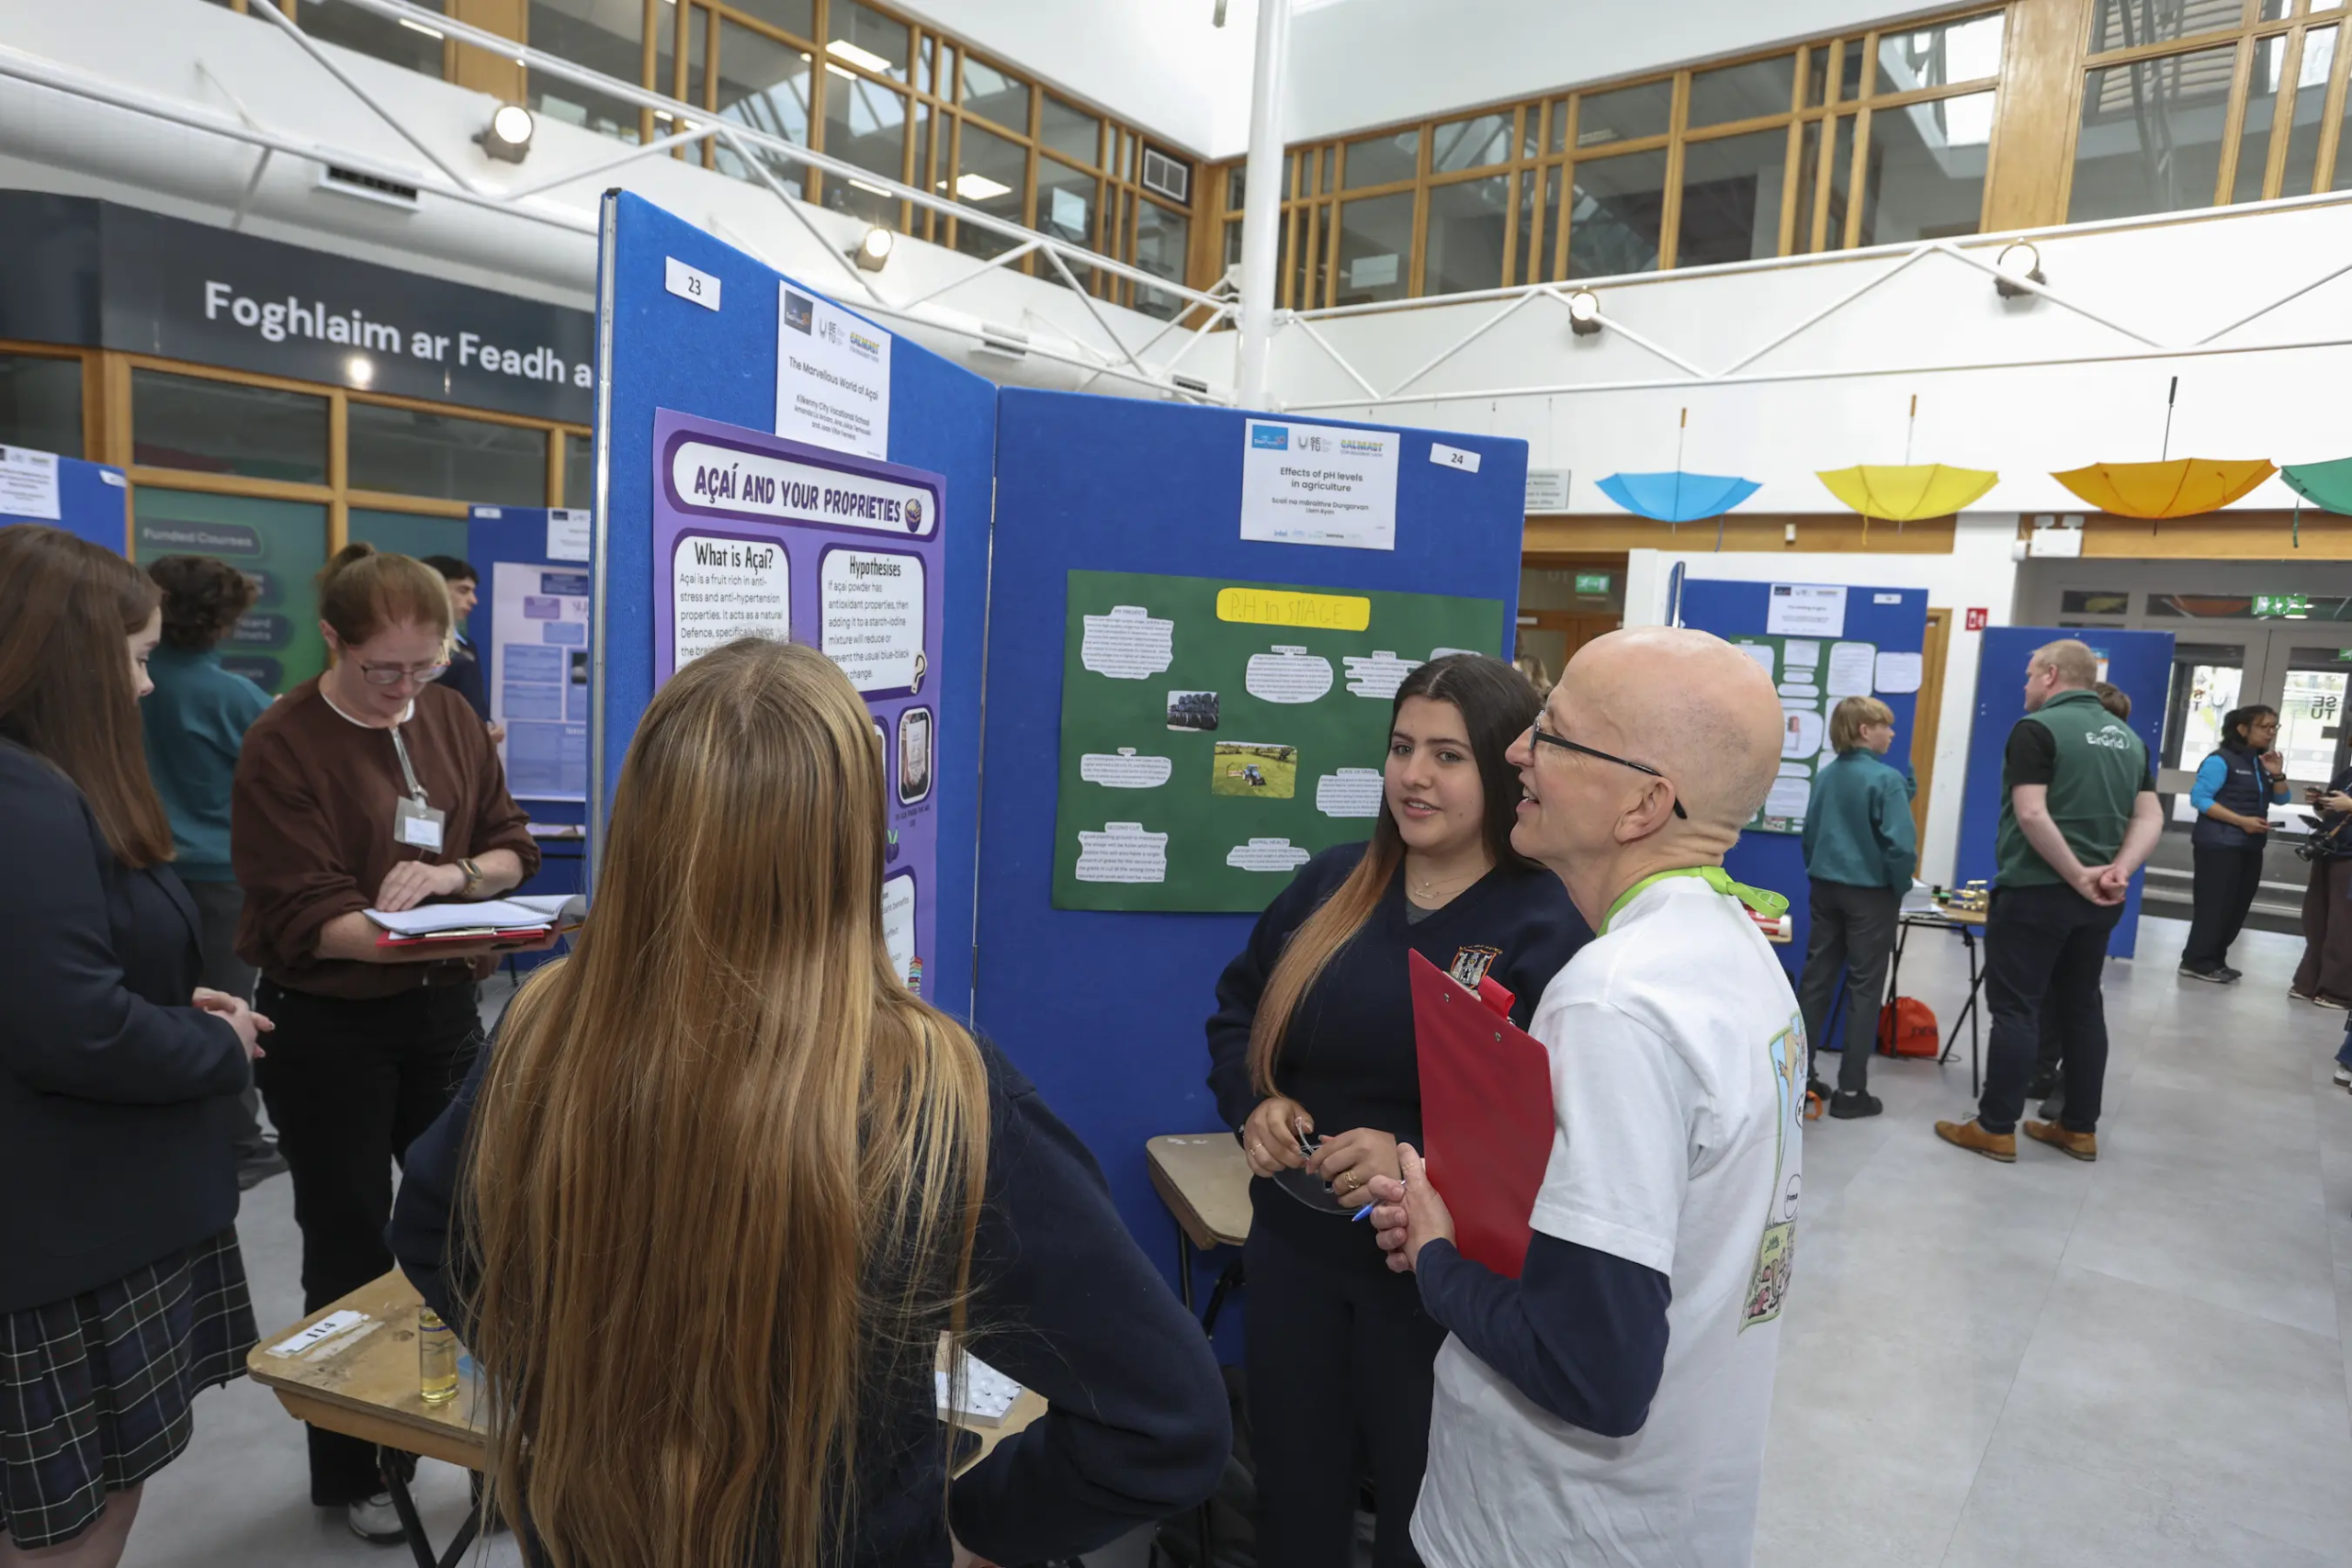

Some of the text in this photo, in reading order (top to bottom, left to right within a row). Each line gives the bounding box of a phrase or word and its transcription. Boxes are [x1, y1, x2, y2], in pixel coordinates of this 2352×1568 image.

[689, 276, 701, 296] 23
[206, 280, 401, 353] Foghlaim
[412, 332, 450, 361] ar
[459, 332, 565, 383] Feadh
[790, 356, 801, 370] The
[803, 362, 838, 385] Marvellous
[840, 377, 856, 392] World
[858, 385, 864, 394] of
[797, 394, 869, 426] Kilkenny City Vocational School
[1310, 436, 1321, 445] SE
[1452, 454, 1464, 464] 24
[1281, 468, 1310, 477] Effects
[1323, 472, 1335, 480] pH
[1338, 473, 1363, 481] levels
[1292, 479, 1351, 491] in agriculture
[695, 463, 901, 523] AÇAÍ AND YOUR PROPRIETIES
[1333, 502, 1369, 511] Dungarvan
[695, 542, 728, 567] What
[731, 546, 741, 567] is
[850, 555, 900, 580] Hypothesises
[698, 573, 704, 583] is
[711, 575, 727, 585] fruit
[729, 576, 741, 585] rich
[744, 577, 750, 585] in
[752, 577, 767, 586] anti-
[828, 581, 832, 591] If
[849, 582, 870, 592] powder
[872, 583, 882, 592] has
[680, 593, 780, 604] stress and anti-hypertension
[829, 600, 863, 609] antioxidant
[681, 610, 721, 622] properties.
[723, 611, 729, 619] It
[761, 610, 783, 619] natural
[829, 617, 850, 629] adding
[852, 617, 855, 626] it
[857, 618, 864, 626] to
[681, 627, 714, 638] Defence,
[829, 636, 852, 645] mixture
[854, 635, 863, 644] will
[865, 634, 884, 643] reduce
[681, 646, 694, 656] the
[854, 652, 864, 661] the
[865, 651, 879, 660] usual
[880, 649, 909, 660] blue-black
